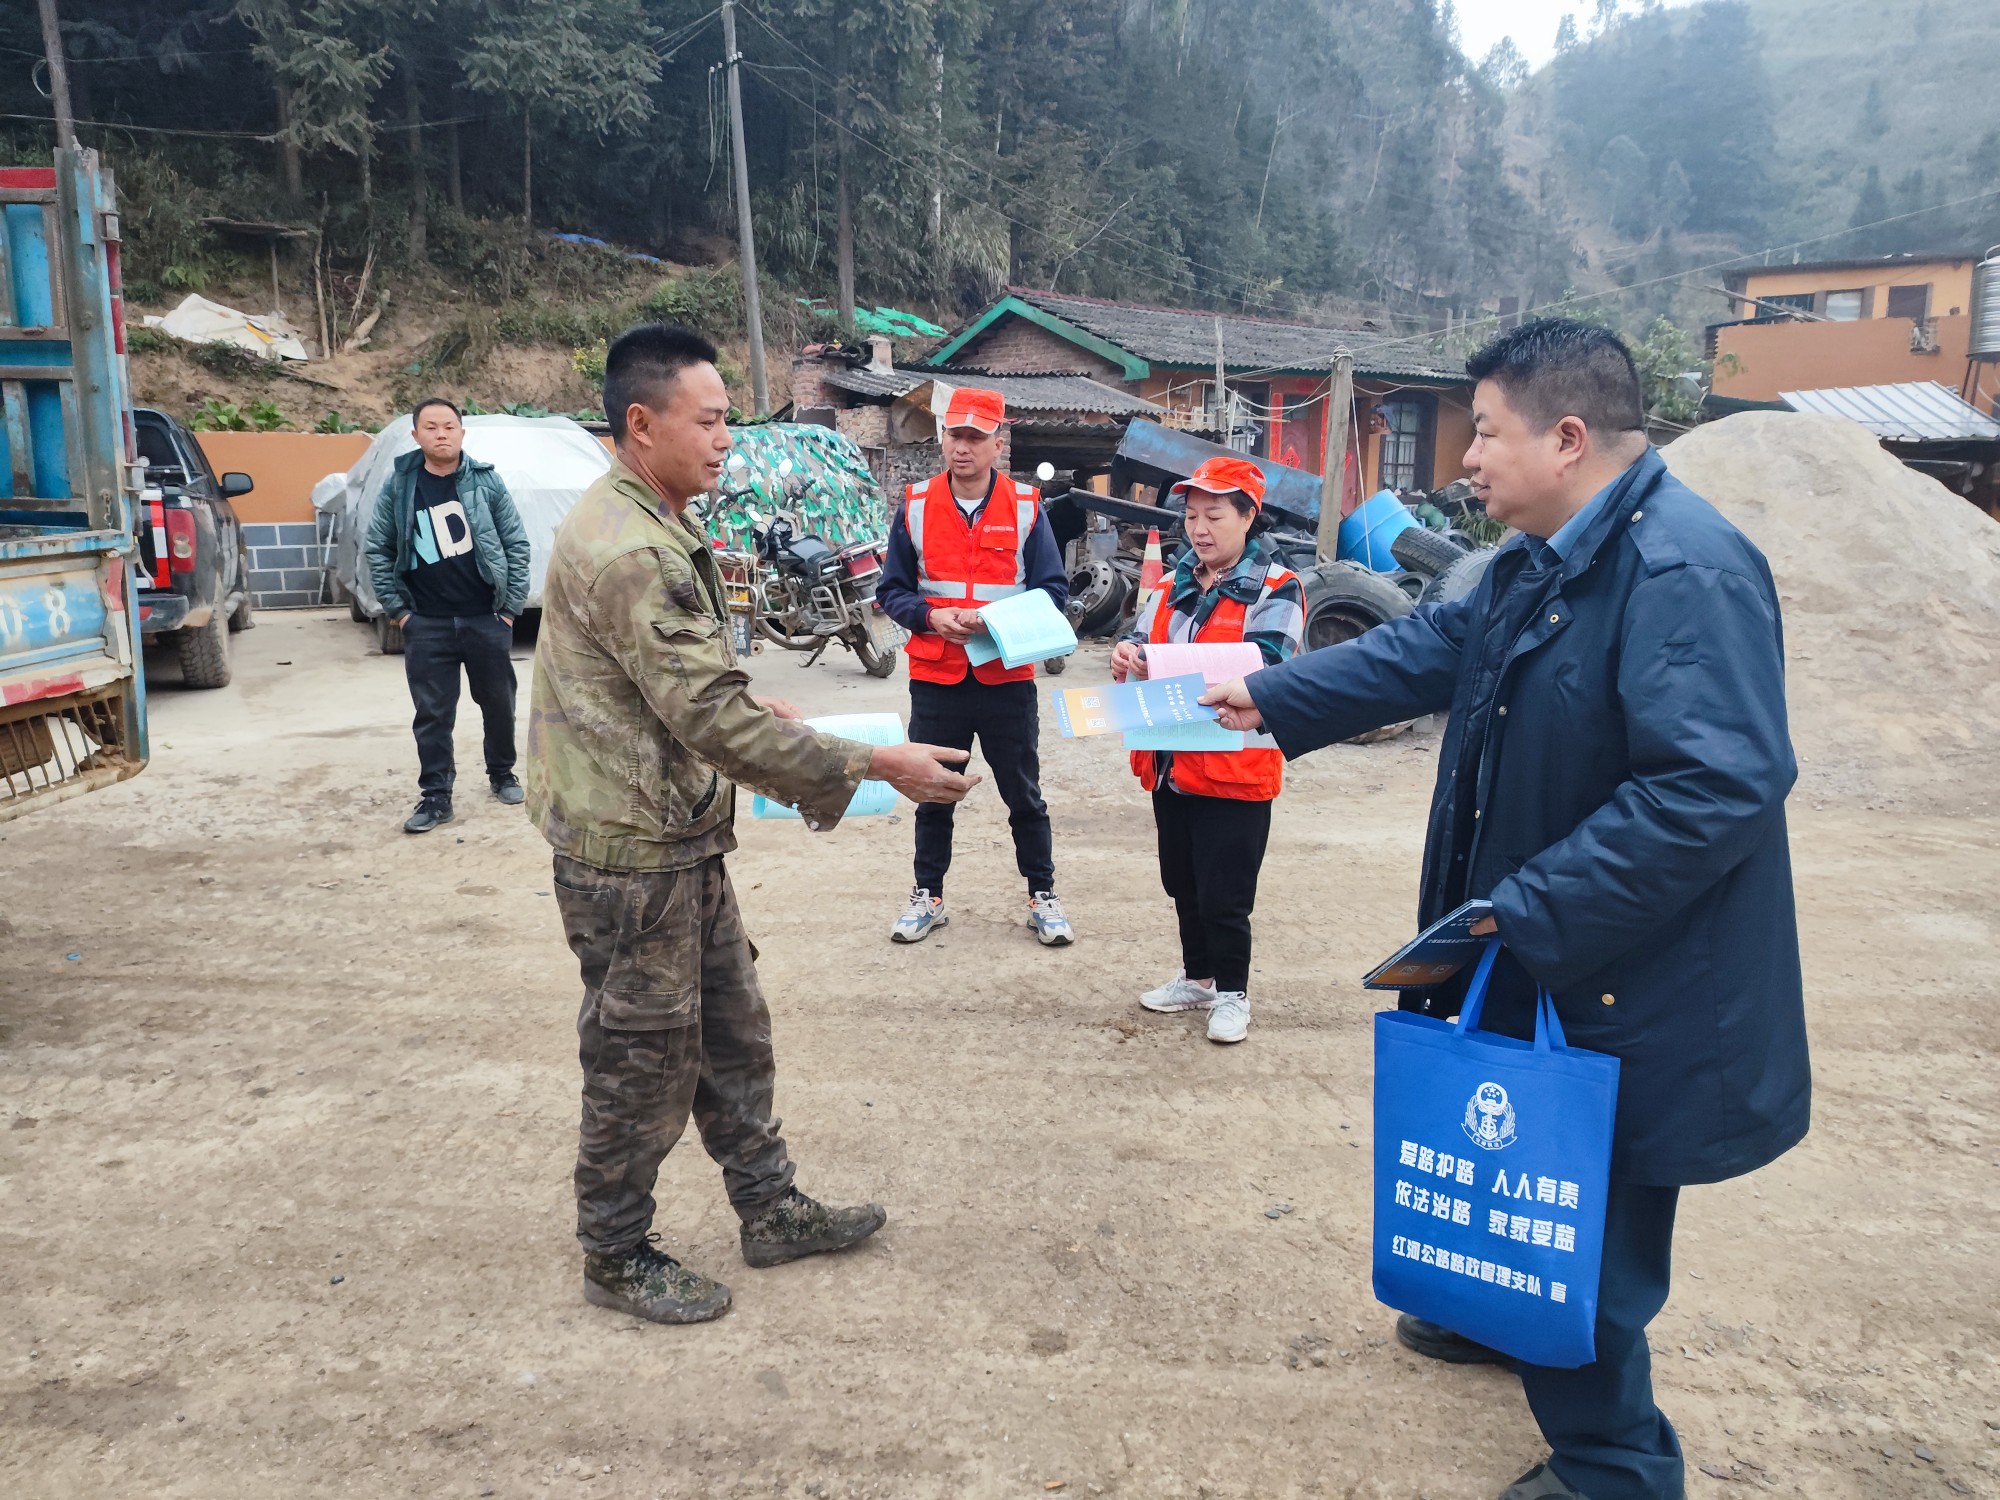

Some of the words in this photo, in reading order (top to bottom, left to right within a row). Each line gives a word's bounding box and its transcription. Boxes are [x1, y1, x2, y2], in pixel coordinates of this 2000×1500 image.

[1399, 1140, 1475, 1186] 爱路护路
[1491, 1169, 1580, 1210] 人人有责
[1395, 1179, 1472, 1226] 依法治路
[1488, 1209, 1576, 1253] 家家受益
[1391, 1235, 1542, 1297] 红河公路路政管理支队
[1550, 1281, 1567, 1304] 宣
